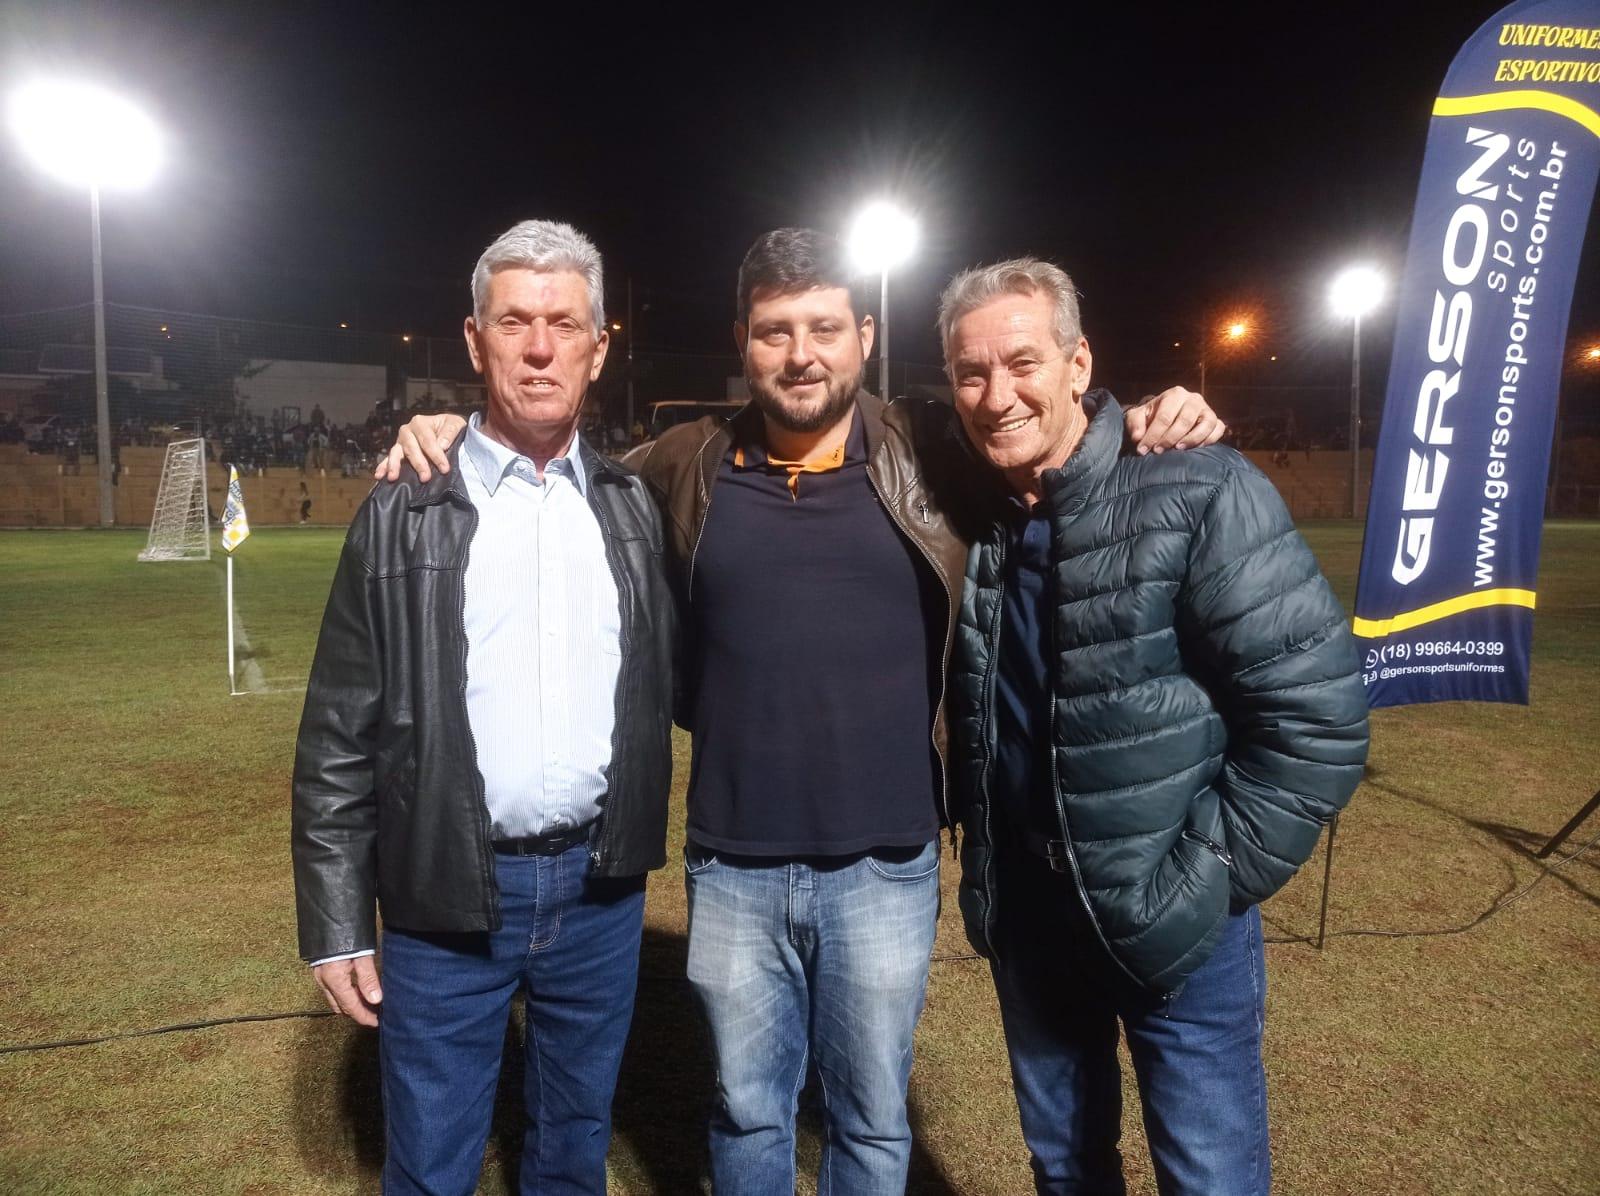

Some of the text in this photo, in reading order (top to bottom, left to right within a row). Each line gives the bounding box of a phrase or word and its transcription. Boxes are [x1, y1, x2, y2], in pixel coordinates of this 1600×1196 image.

[1498, 24, 1600, 49] UNIFORME
[1494, 60, 1600, 83] ESPORTIVO
[1487, 138, 1536, 293] sports
[1391, 127, 1510, 586] GERSON
[1474, 141, 1567, 587] www.gersonsports.com.br
[1380, 641, 1504, 663] (18) 99664-0399
[1379, 662, 1505, 679] @gersonsportsuniformes
